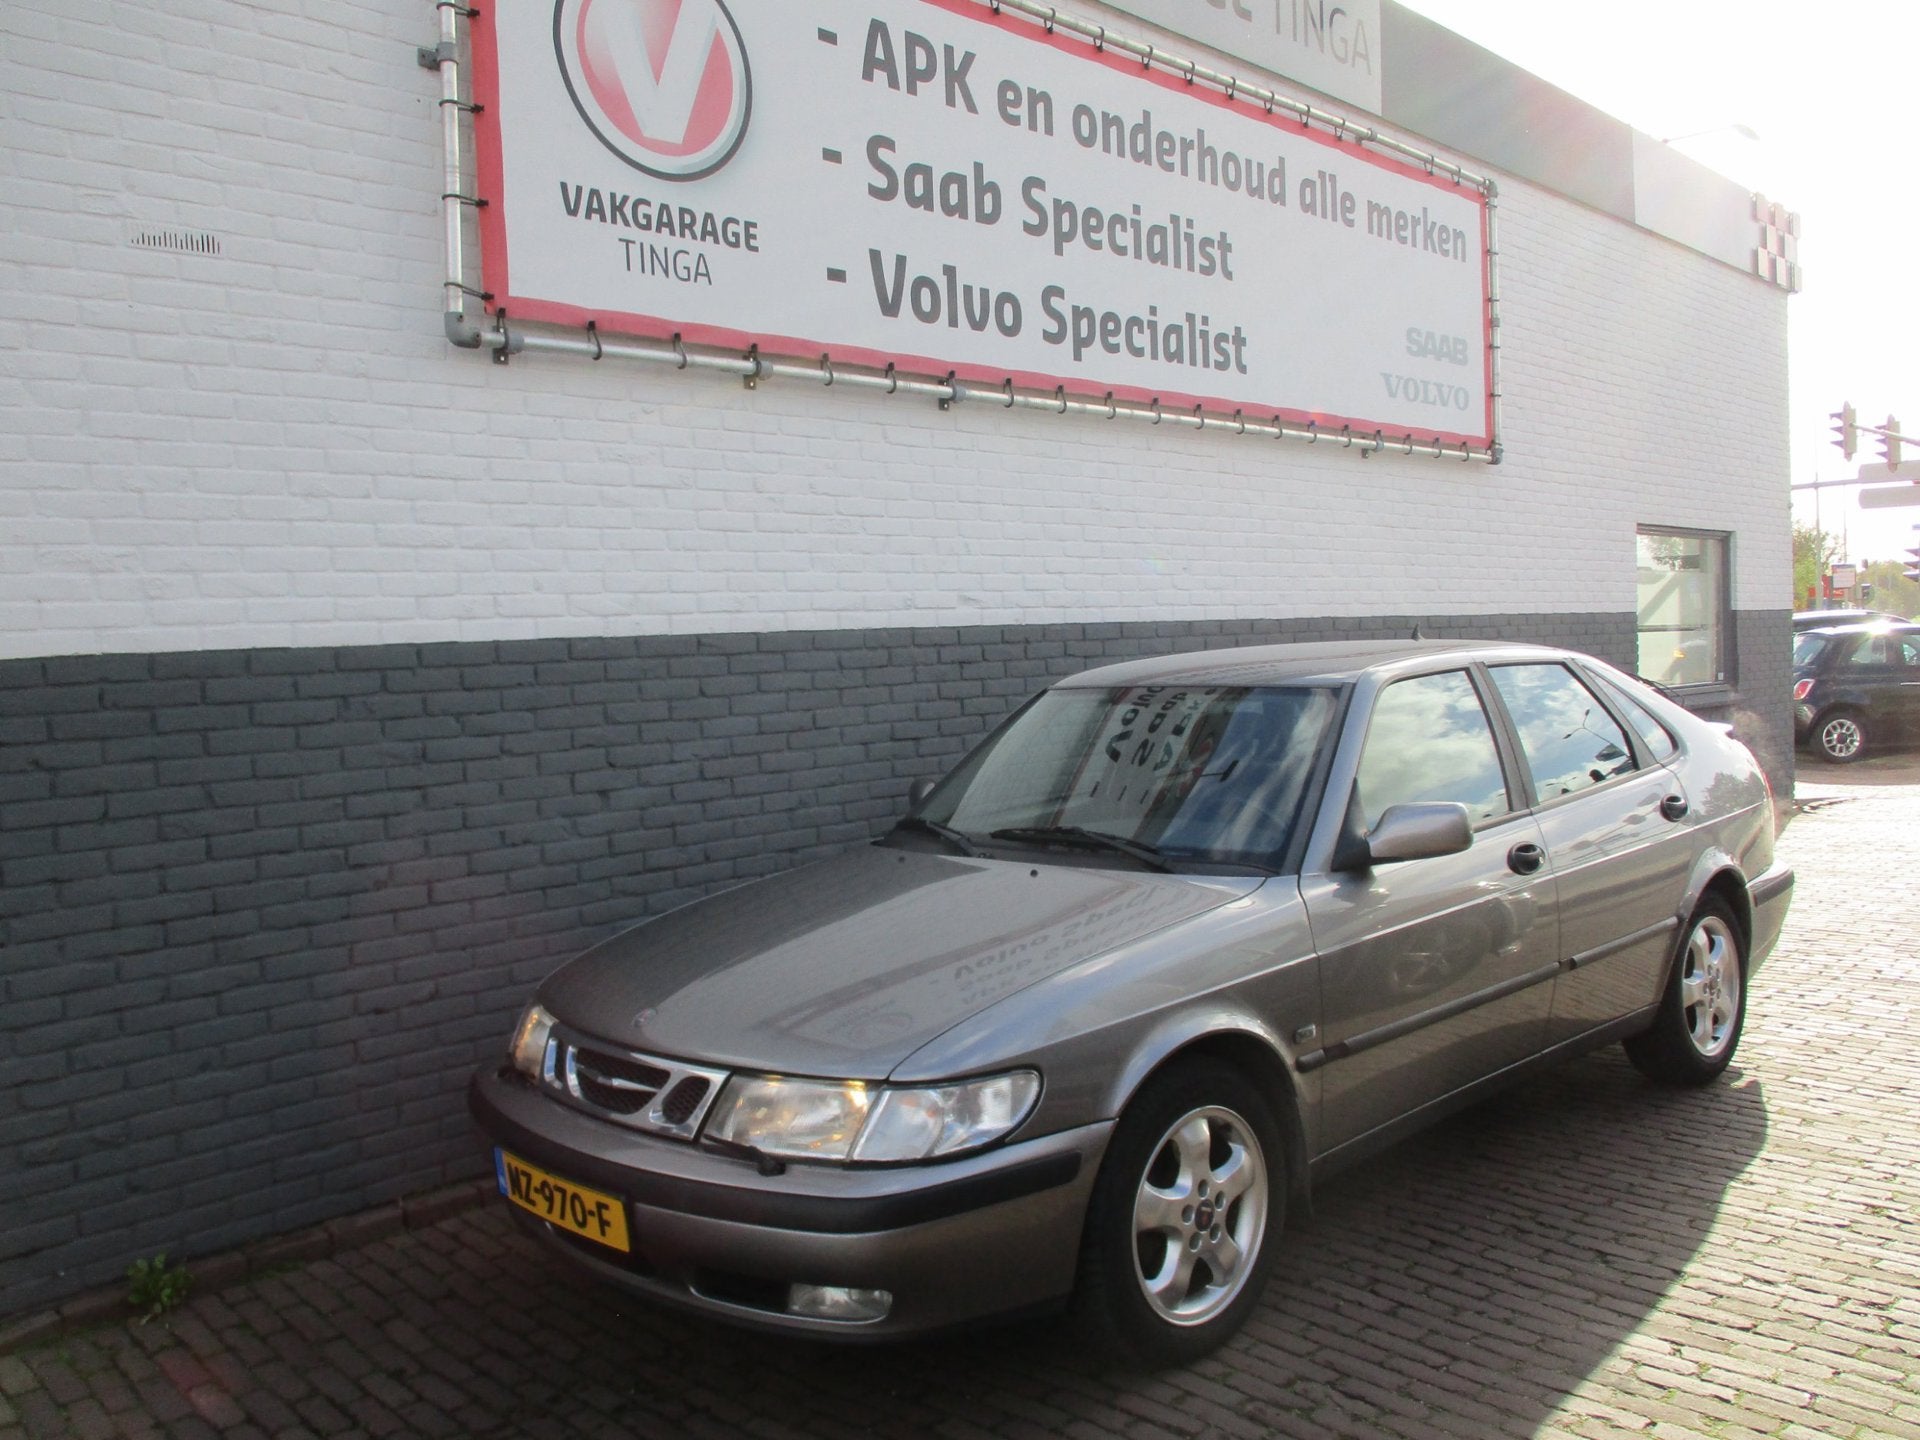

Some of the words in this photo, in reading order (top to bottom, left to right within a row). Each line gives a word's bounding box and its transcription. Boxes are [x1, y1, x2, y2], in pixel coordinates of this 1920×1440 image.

[861, 17, 979, 115] APK
[997, 79, 1054, 137] en
[1072, 103, 1287, 207] onderhoud
[1299, 169, 1355, 227] alle
[1366, 197, 1467, 262] merken
[559, 181, 760, 253] VAKGARAGE
[866, 134, 1002, 225] Saab
[1021, 175, 1233, 281] Specialist
[618, 237, 713, 286] TINGA
[868, 248, 1023, 338] Volvo
[1041, 285, 1248, 375] Specialist
[1406, 326, 1469, 367] SAAB
[1380, 372, 1470, 412] VOLVO
[507, 1162, 612, 1237] NZ-970-F
